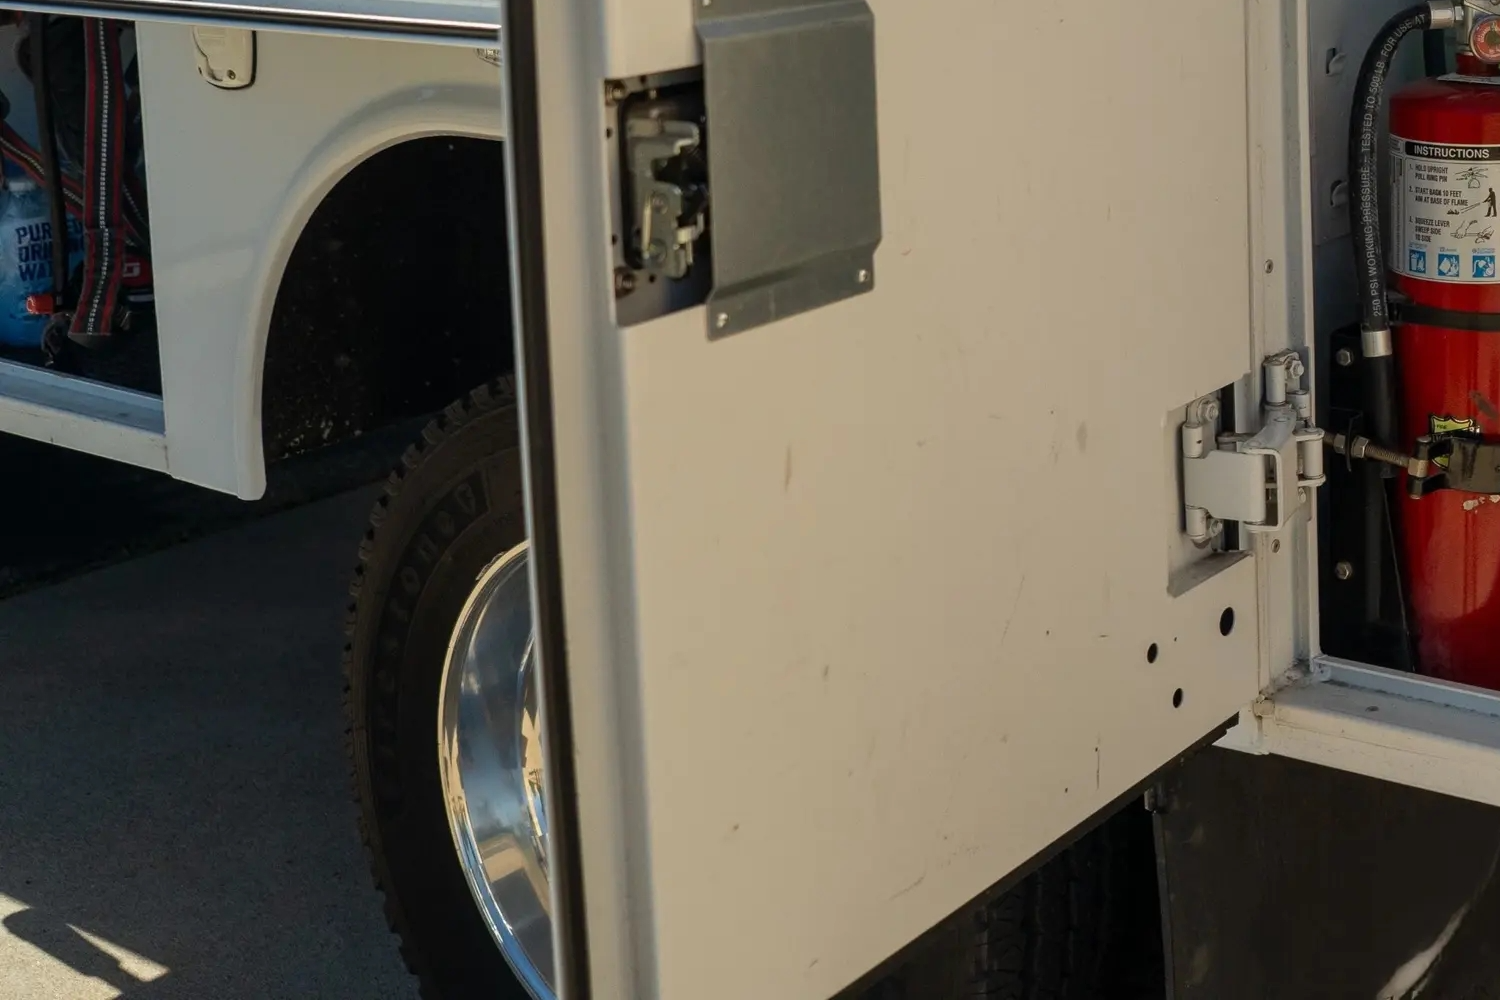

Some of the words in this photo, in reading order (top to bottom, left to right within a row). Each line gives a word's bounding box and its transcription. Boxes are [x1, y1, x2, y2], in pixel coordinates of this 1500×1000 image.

[1394, 19, 1413, 37] USE
[1415, 14, 1425, 25] AT
[1381, 36, 1397, 57] FOR
[1365, 96, 1376, 110] TO
[1361, 113, 1373, 153] TESTED
[1414, 145, 1490, 158] INSTRUCTIONS
[1415, 172, 1425, 180] PULL
[1360, 166, 1372, 222] PRESSURE
[1450, 190, 1462, 198] FEET
[1363, 225, 1378, 276] WORKING
[1370, 279, 1381, 296] PSI
[1372, 299, 1383, 317] 250
